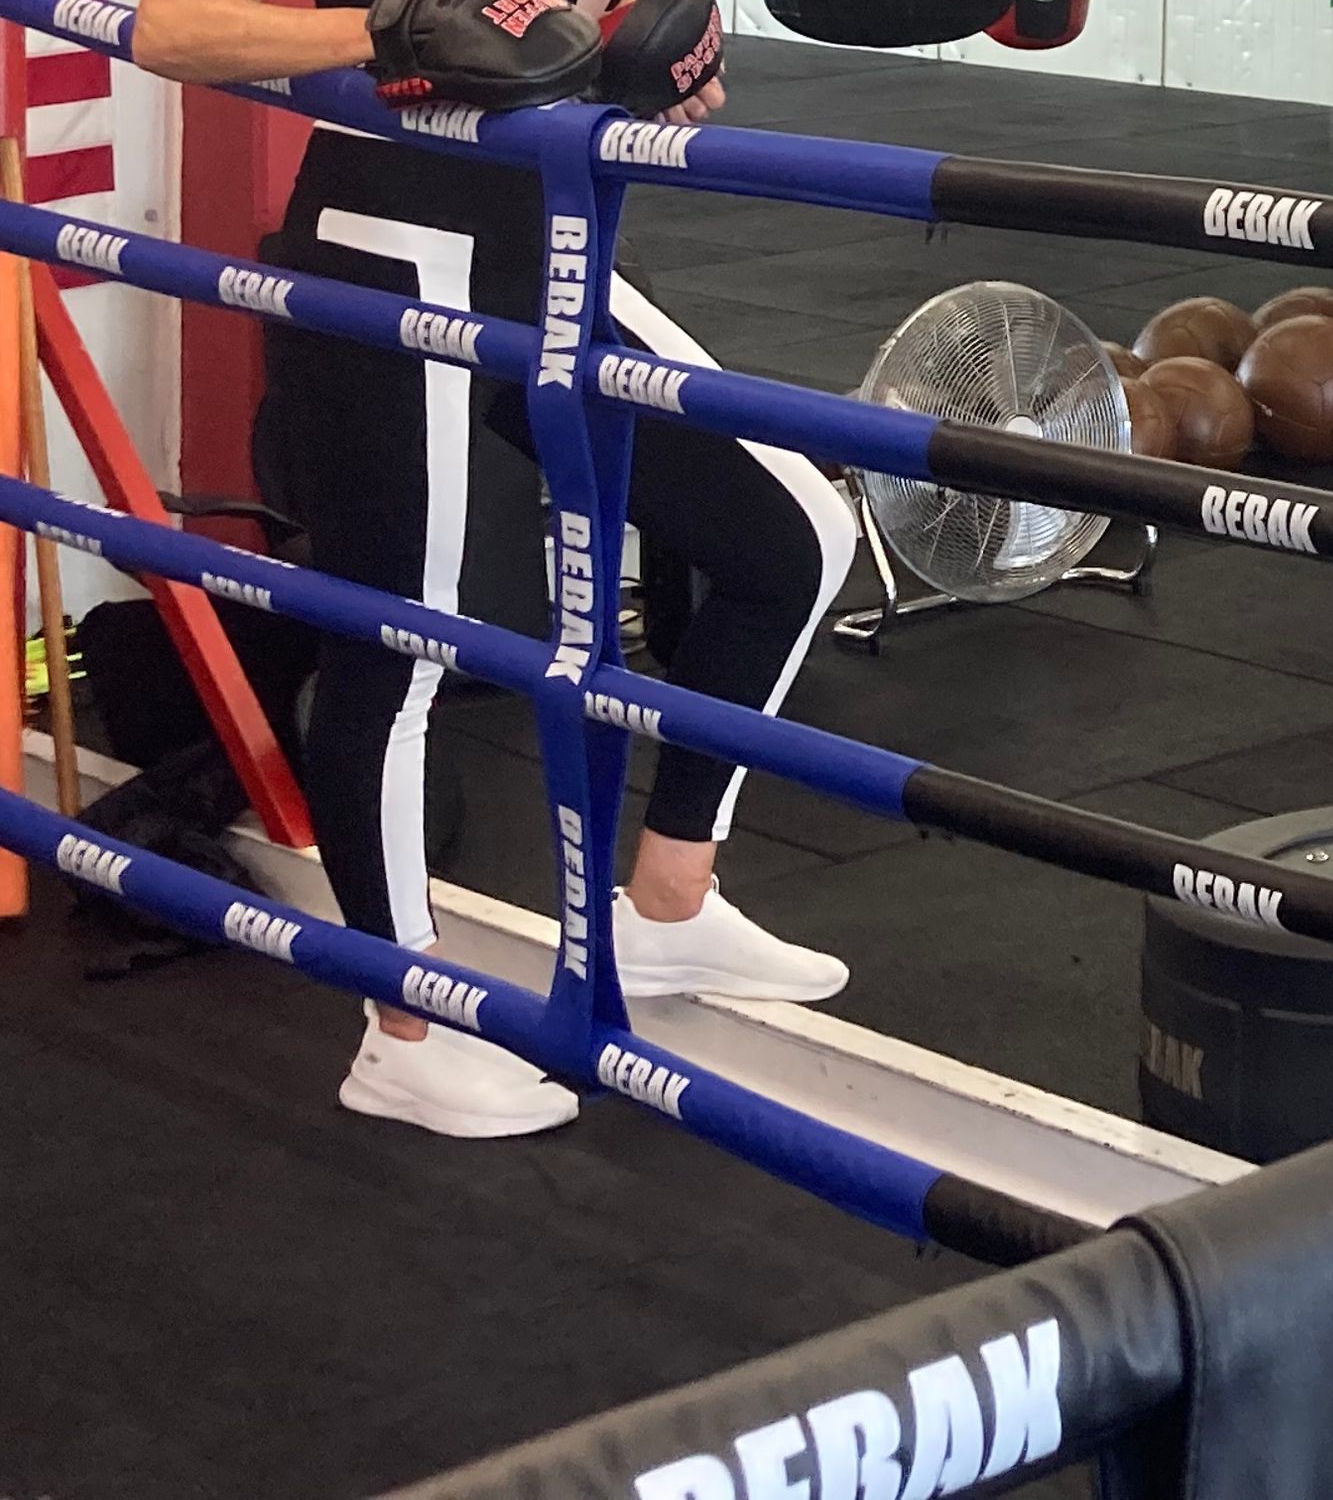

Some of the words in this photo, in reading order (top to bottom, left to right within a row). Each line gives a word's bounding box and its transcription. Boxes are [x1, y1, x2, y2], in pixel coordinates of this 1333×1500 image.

[600, 121, 701, 169] BEBAK
[56, 224, 129, 274] BEBAK
[1203, 188, 1322, 250] BEBAK
[218, 266, 293, 318] BEBAK
[536, 214, 588, 390] BEBAK
[401, 308, 484, 364] BEBAK
[598, 354, 690, 414] BEBAK
[1201, 486, 1319, 554] BEBAK
[545, 510, 594, 686] BEBAK
[1173, 864, 1286, 928] BEBAK
[402, 965, 488, 1031] BEBAK
[598, 1043, 690, 1120] BEBAK
